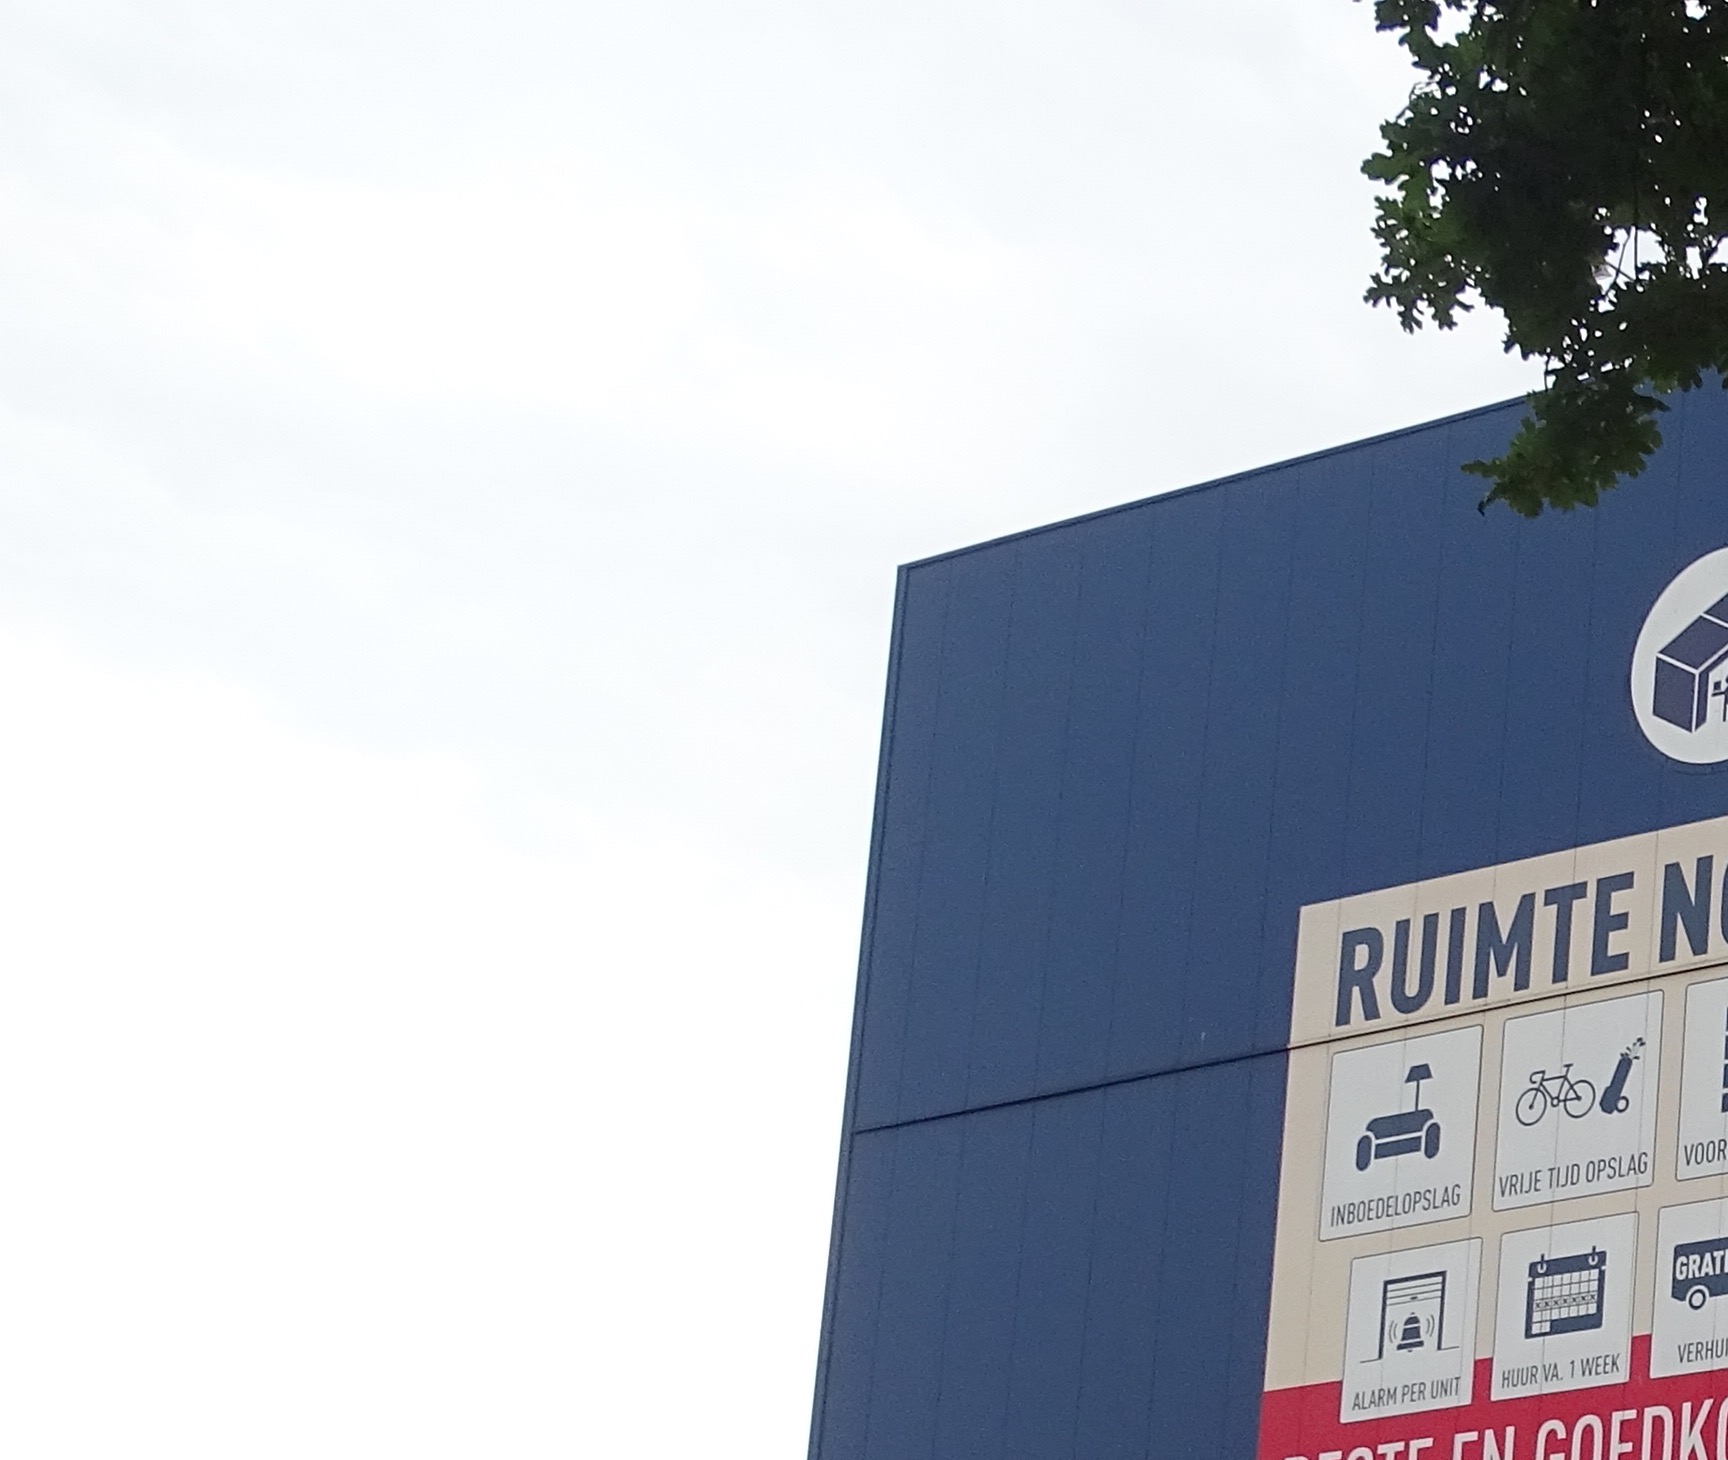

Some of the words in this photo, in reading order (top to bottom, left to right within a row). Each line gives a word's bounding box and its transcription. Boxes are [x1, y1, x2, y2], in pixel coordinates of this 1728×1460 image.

[1335, 871, 1635, 1027] RUIMTE
[1499, 1171, 1541, 1198] VRIJE
[1548, 1164, 1580, 1190] TIJD
[1585, 1152, 1649, 1183] OPSLAG
[1330, 1184, 1461, 1227] INBOEDELOPSLAG
[1501, 1364, 1538, 1389] HUUR
[1542, 1362, 1564, 1383] VA.
[1569, 1360, 1576, 1380] 1
[1580, 1353, 1621, 1377] WEEK
[1352, 1383, 1397, 1412] ALARM
[1401, 1382, 1426, 1406] PER
[1431, 1375, 1461, 1402] UNIT
